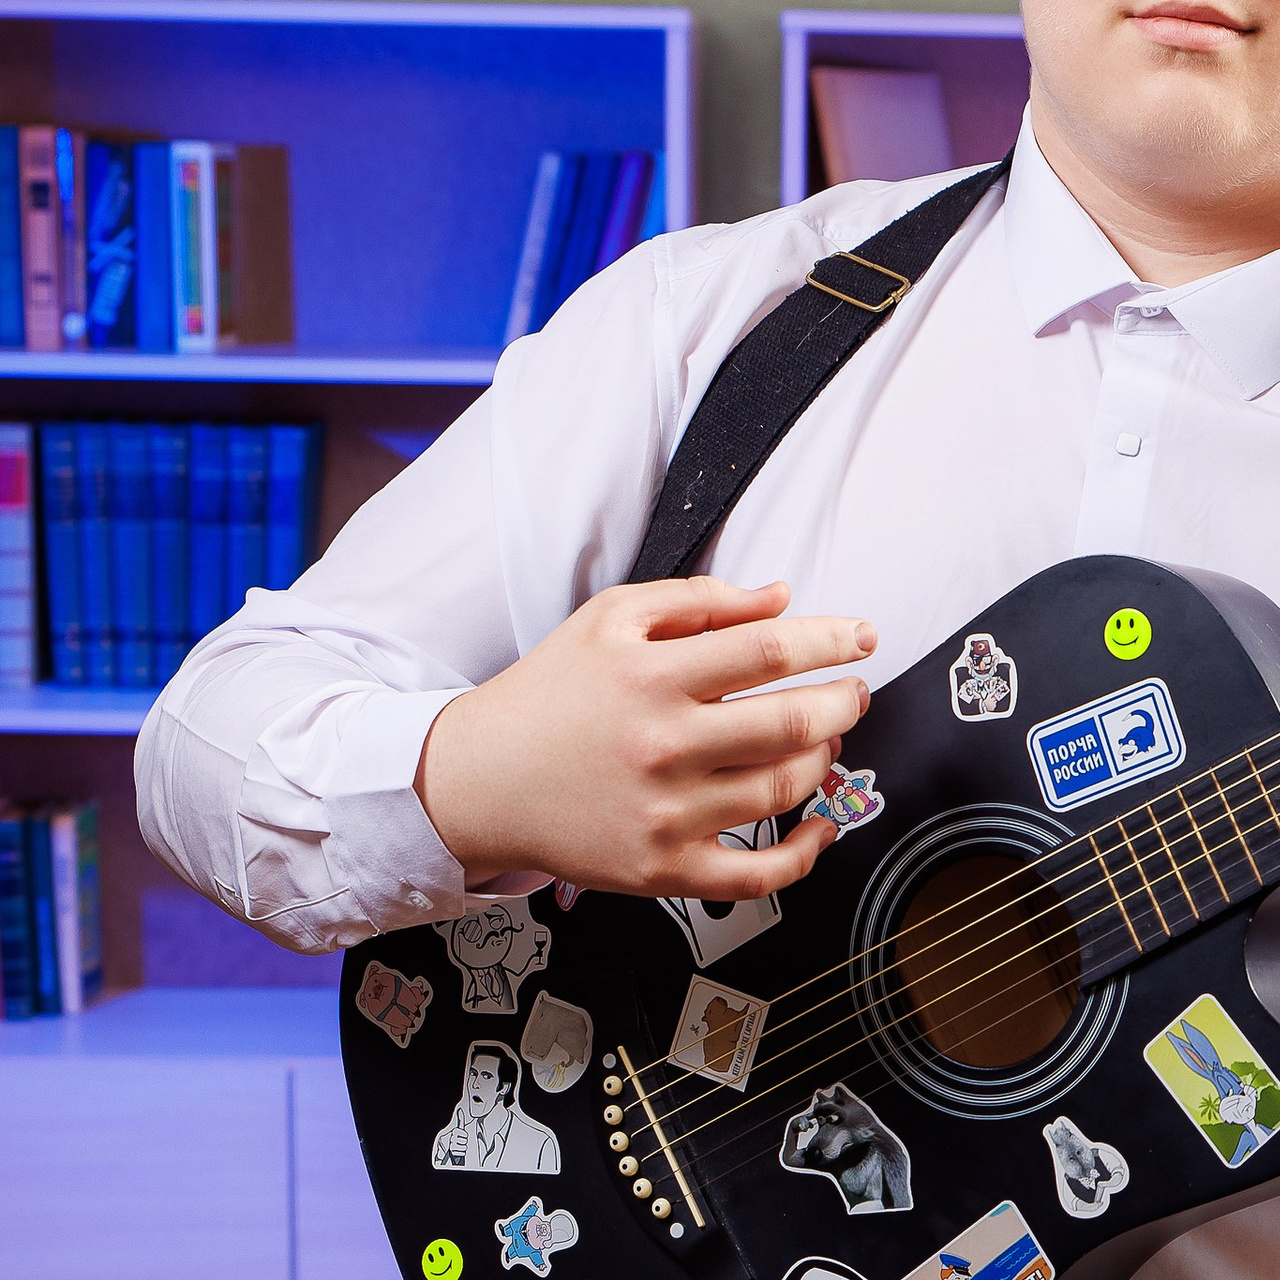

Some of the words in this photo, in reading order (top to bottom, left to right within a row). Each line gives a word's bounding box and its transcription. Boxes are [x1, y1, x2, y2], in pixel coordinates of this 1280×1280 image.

[1047, 733, 1098, 765] ПОРЧА
[1053, 751, 1104, 784] РОССИИ
[732, 1063, 741, 1076] KEEP
